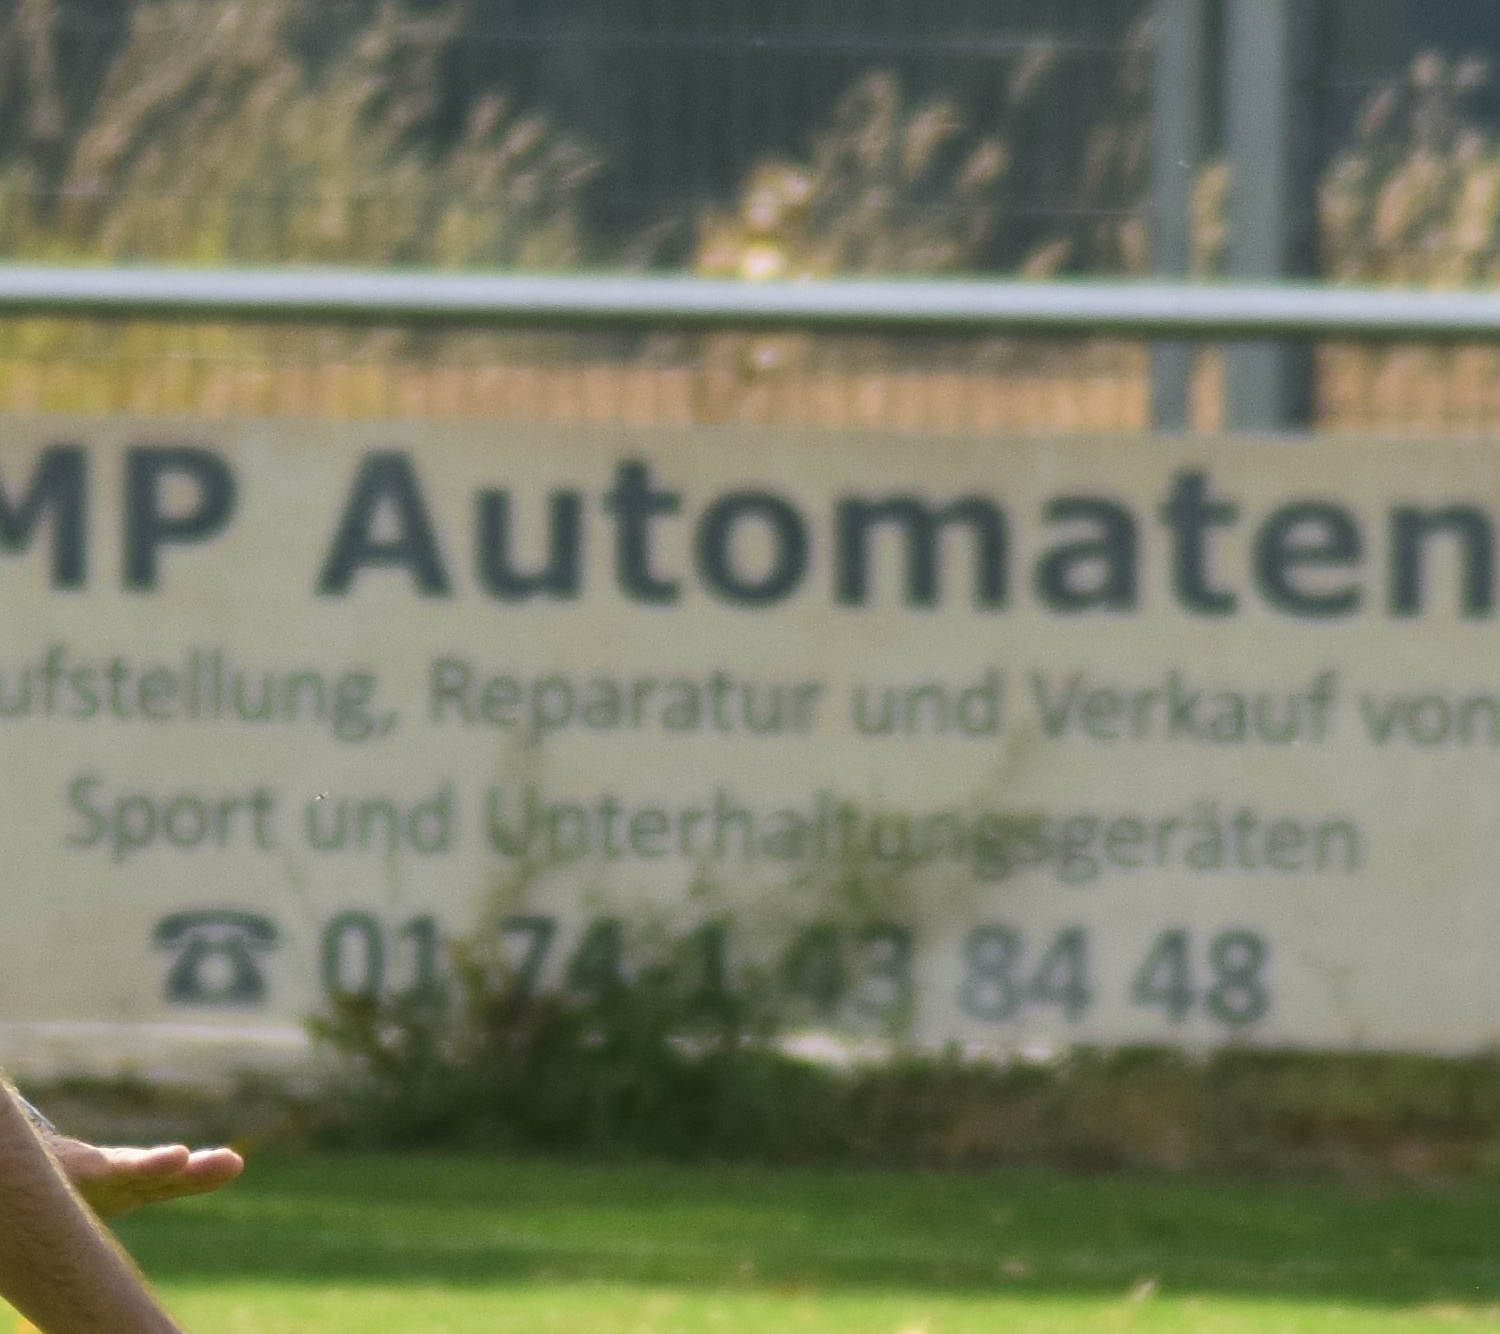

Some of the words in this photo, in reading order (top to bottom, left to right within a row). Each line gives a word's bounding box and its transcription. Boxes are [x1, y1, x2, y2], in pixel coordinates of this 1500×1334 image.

[314, 447, 1497, 618] Automaten
[428, 657, 822, 747] Reparatur
[850, 669, 1004, 739] und
[1030, 670, 1339, 745] Verkauf
[65, 774, 277, 863] Sport
[304, 780, 455, 854] und
[957, 921, 1093, 1025] 84
[1130, 925, 1272, 1029] 48
